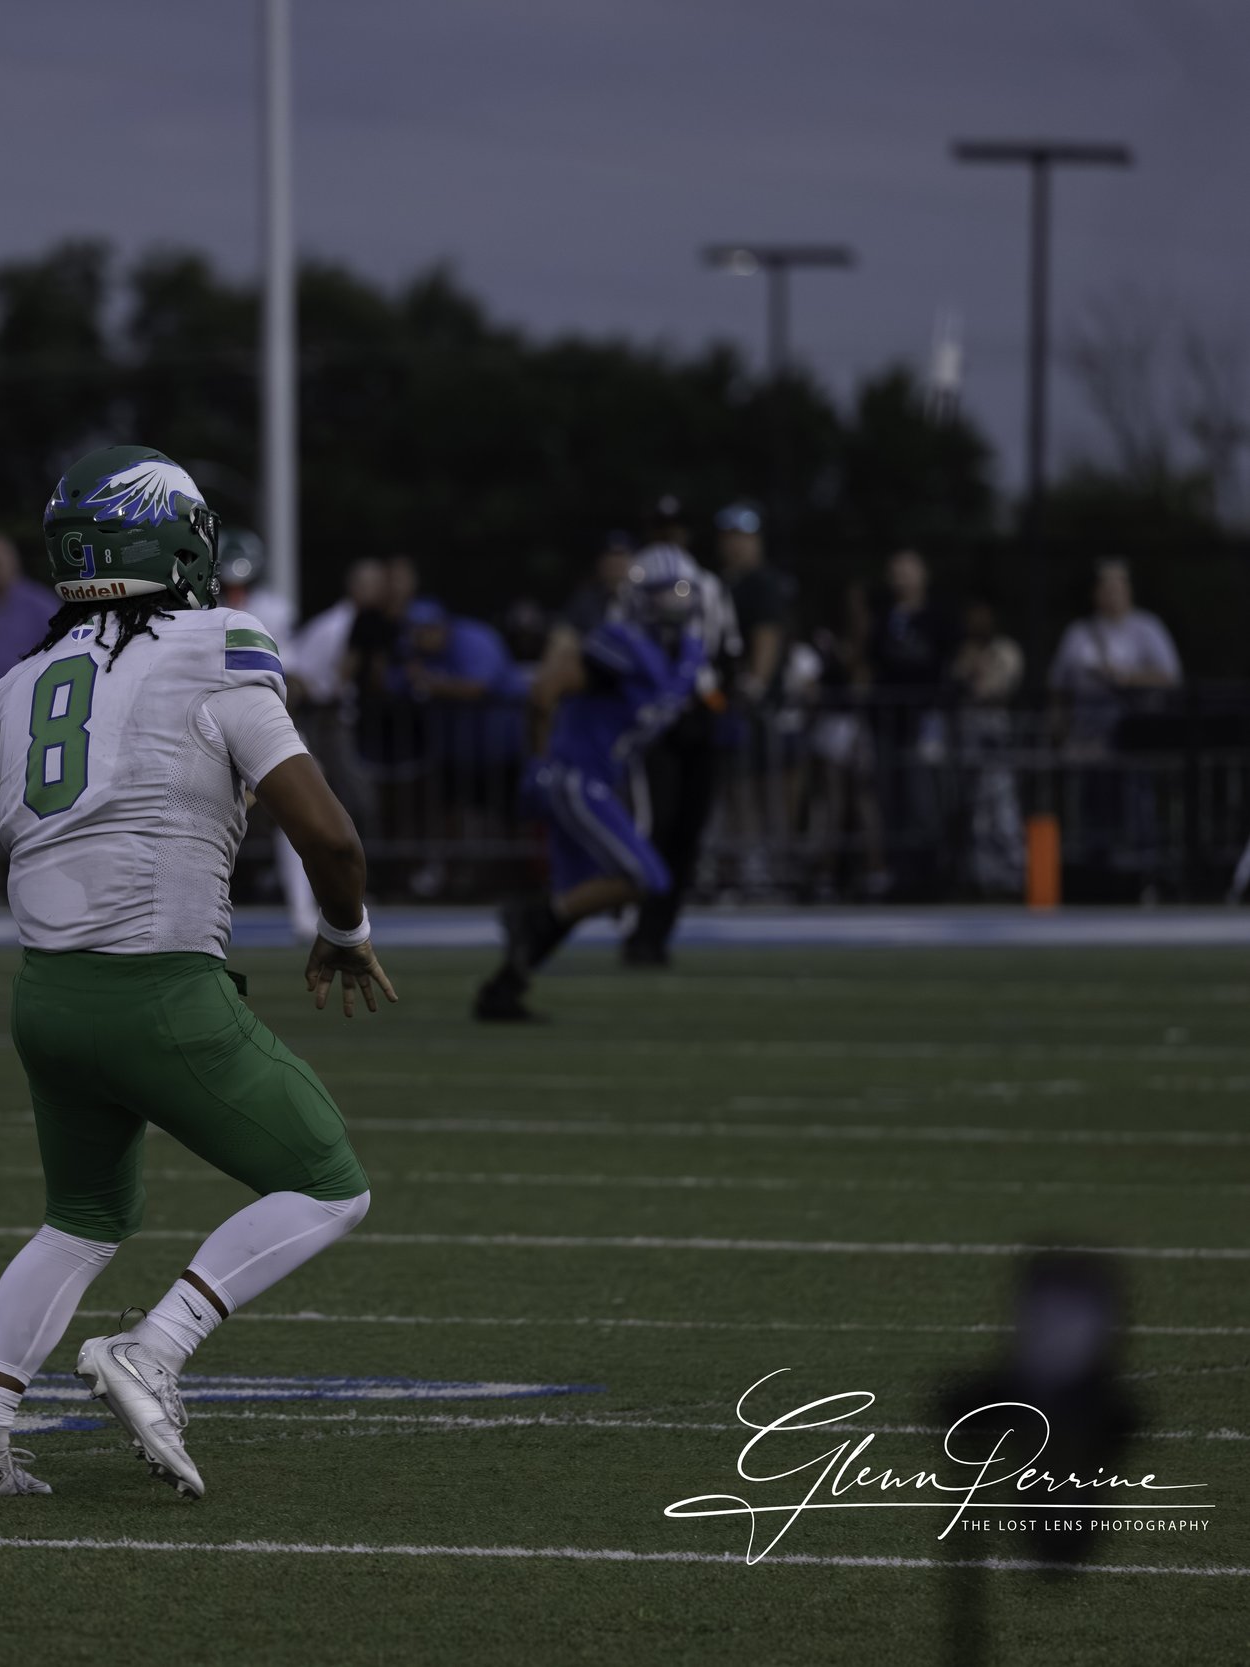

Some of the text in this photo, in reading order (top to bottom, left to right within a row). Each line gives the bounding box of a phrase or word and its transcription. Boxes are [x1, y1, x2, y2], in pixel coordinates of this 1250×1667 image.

[104, 548, 112, 565] 8
[60, 583, 127, 600] Riddell
[23, 652, 98, 820] 8
